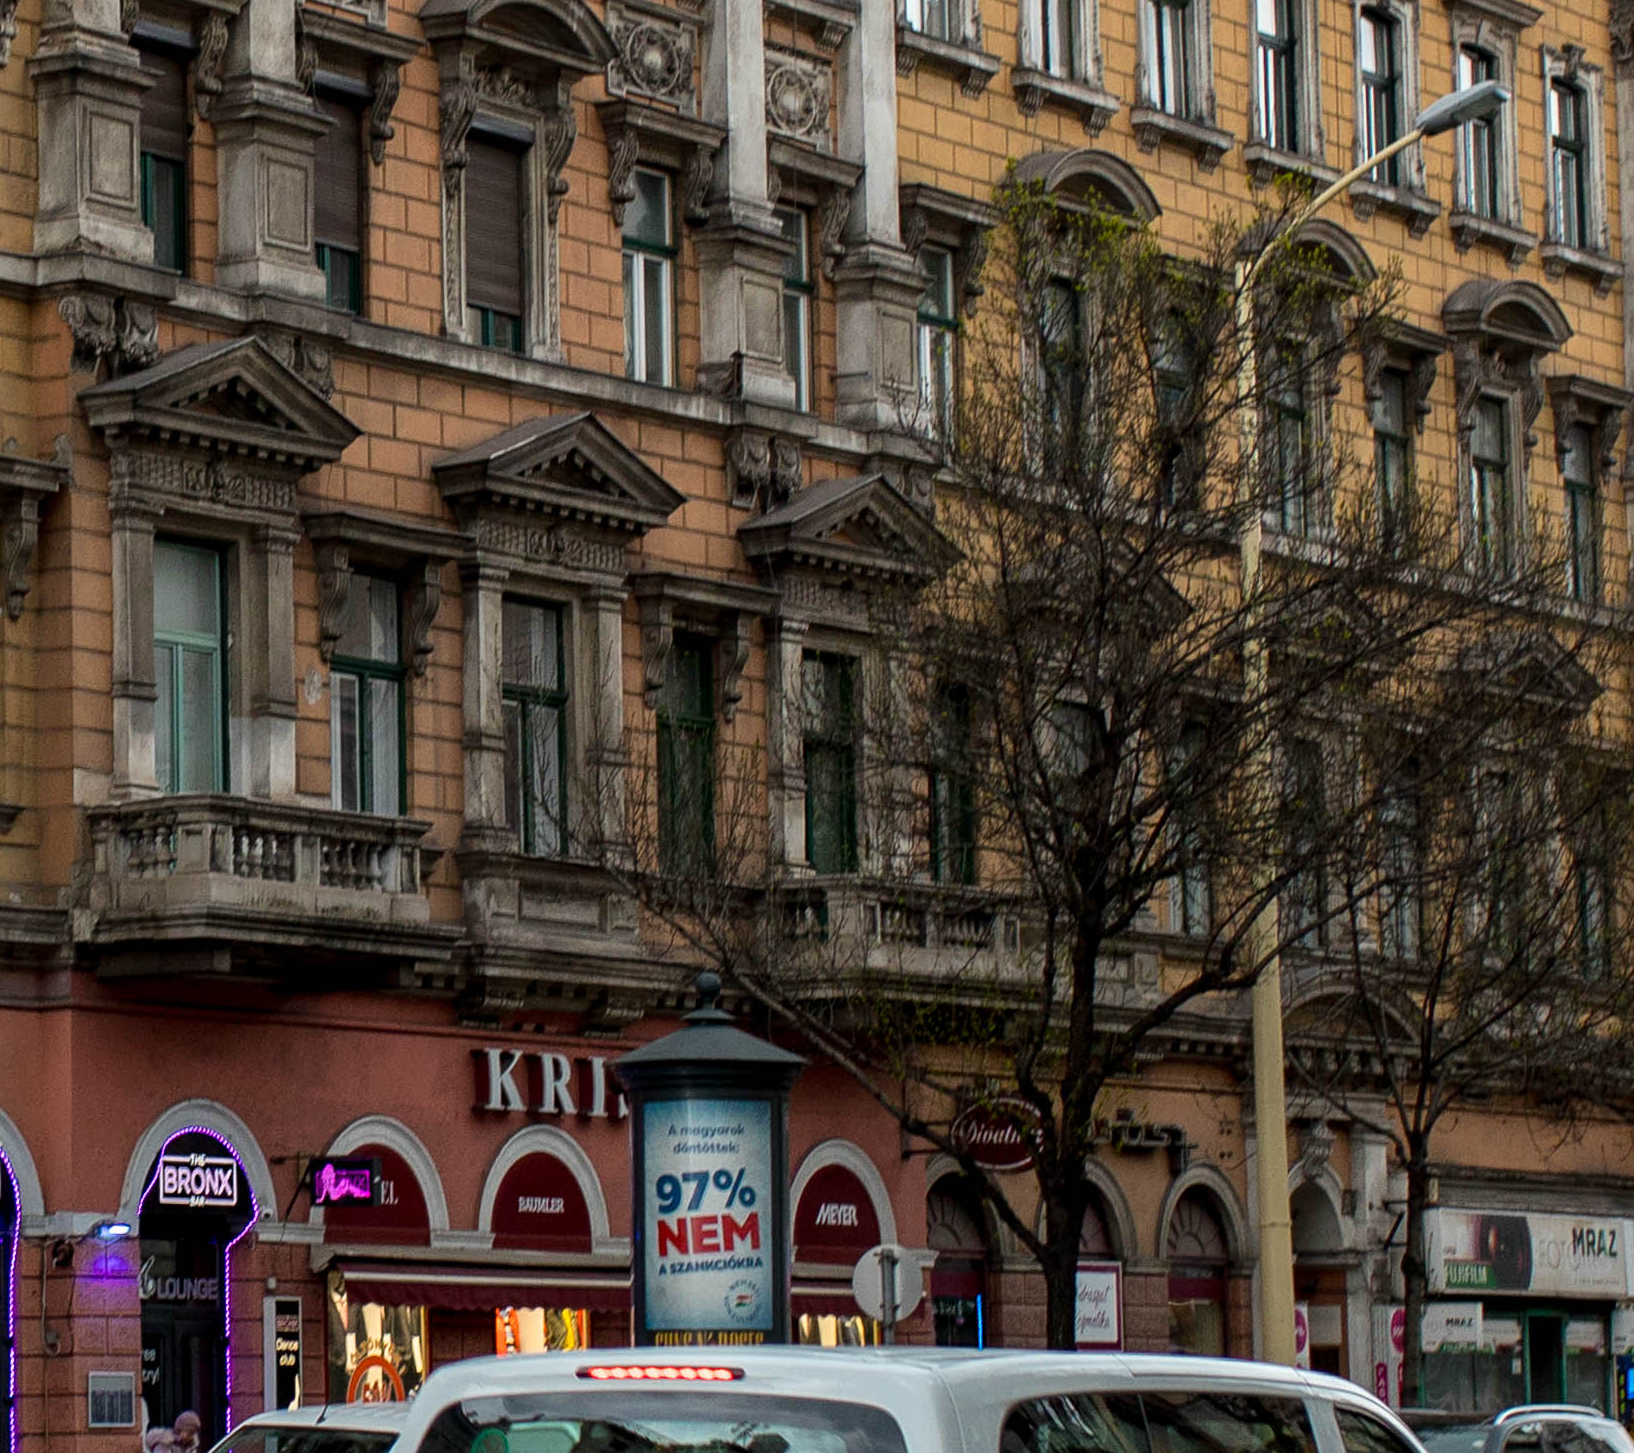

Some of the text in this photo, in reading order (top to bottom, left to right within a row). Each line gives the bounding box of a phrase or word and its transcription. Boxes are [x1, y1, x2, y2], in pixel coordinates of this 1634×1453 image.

[163, 1164, 233, 1197] BRONX
[655, 1166, 757, 1215] 97%
[814, 1203, 859, 1227] MEYER
[656, 1211, 761, 1259] NEM
[156, 1276, 219, 1300] LOUNGE
